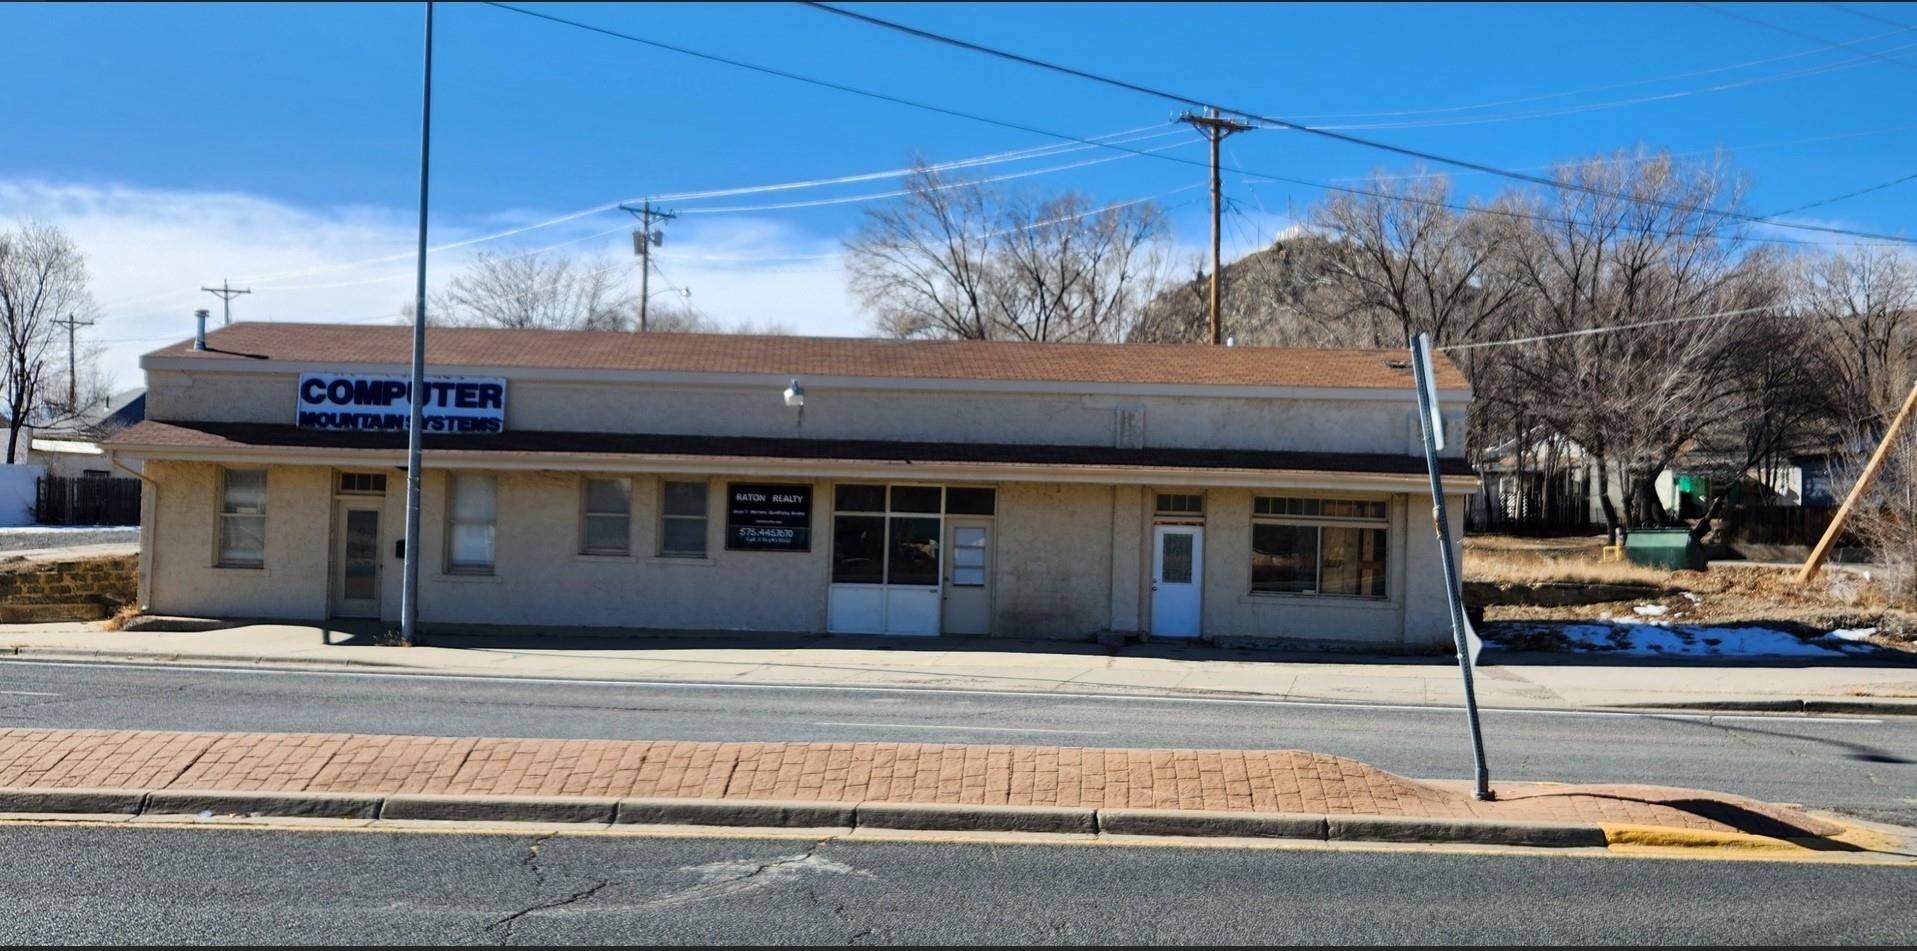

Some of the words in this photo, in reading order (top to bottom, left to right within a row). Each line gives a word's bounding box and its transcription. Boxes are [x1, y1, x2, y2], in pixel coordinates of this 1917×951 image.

[301, 378, 503, 408] COMPUTER
[301, 411, 404, 430] MOUNTAIN
[736, 493, 766, 502] RATON
[772, 494, 803, 503] REALTY
